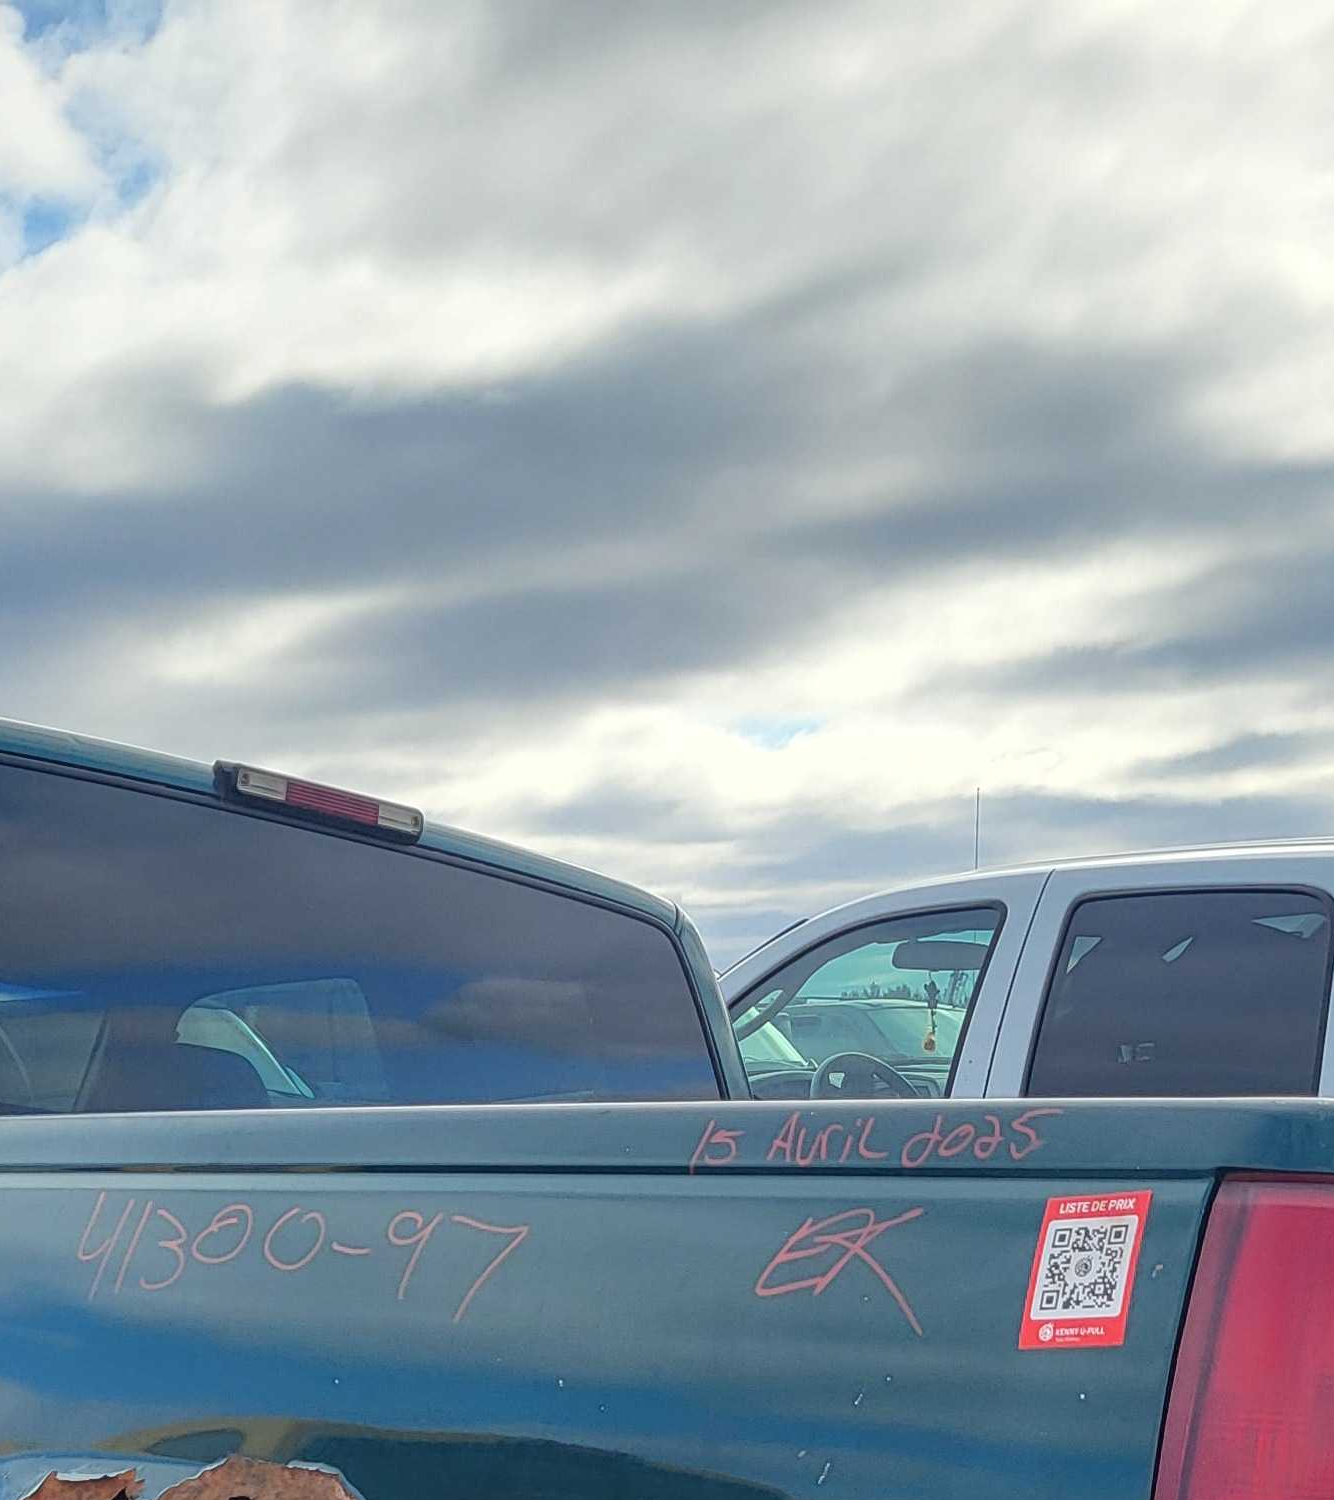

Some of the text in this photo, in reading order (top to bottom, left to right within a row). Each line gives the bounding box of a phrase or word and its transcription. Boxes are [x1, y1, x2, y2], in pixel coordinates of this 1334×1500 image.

[688, 1118, 746, 1175] 15
[900, 1107, 1065, 1169] 2025
[1058, 1197, 1137, 1215] LISTE DE PRIX
[77, 1192, 530, 1324] 41300-97
[1055, 1327, 1080, 1337] KENNY
